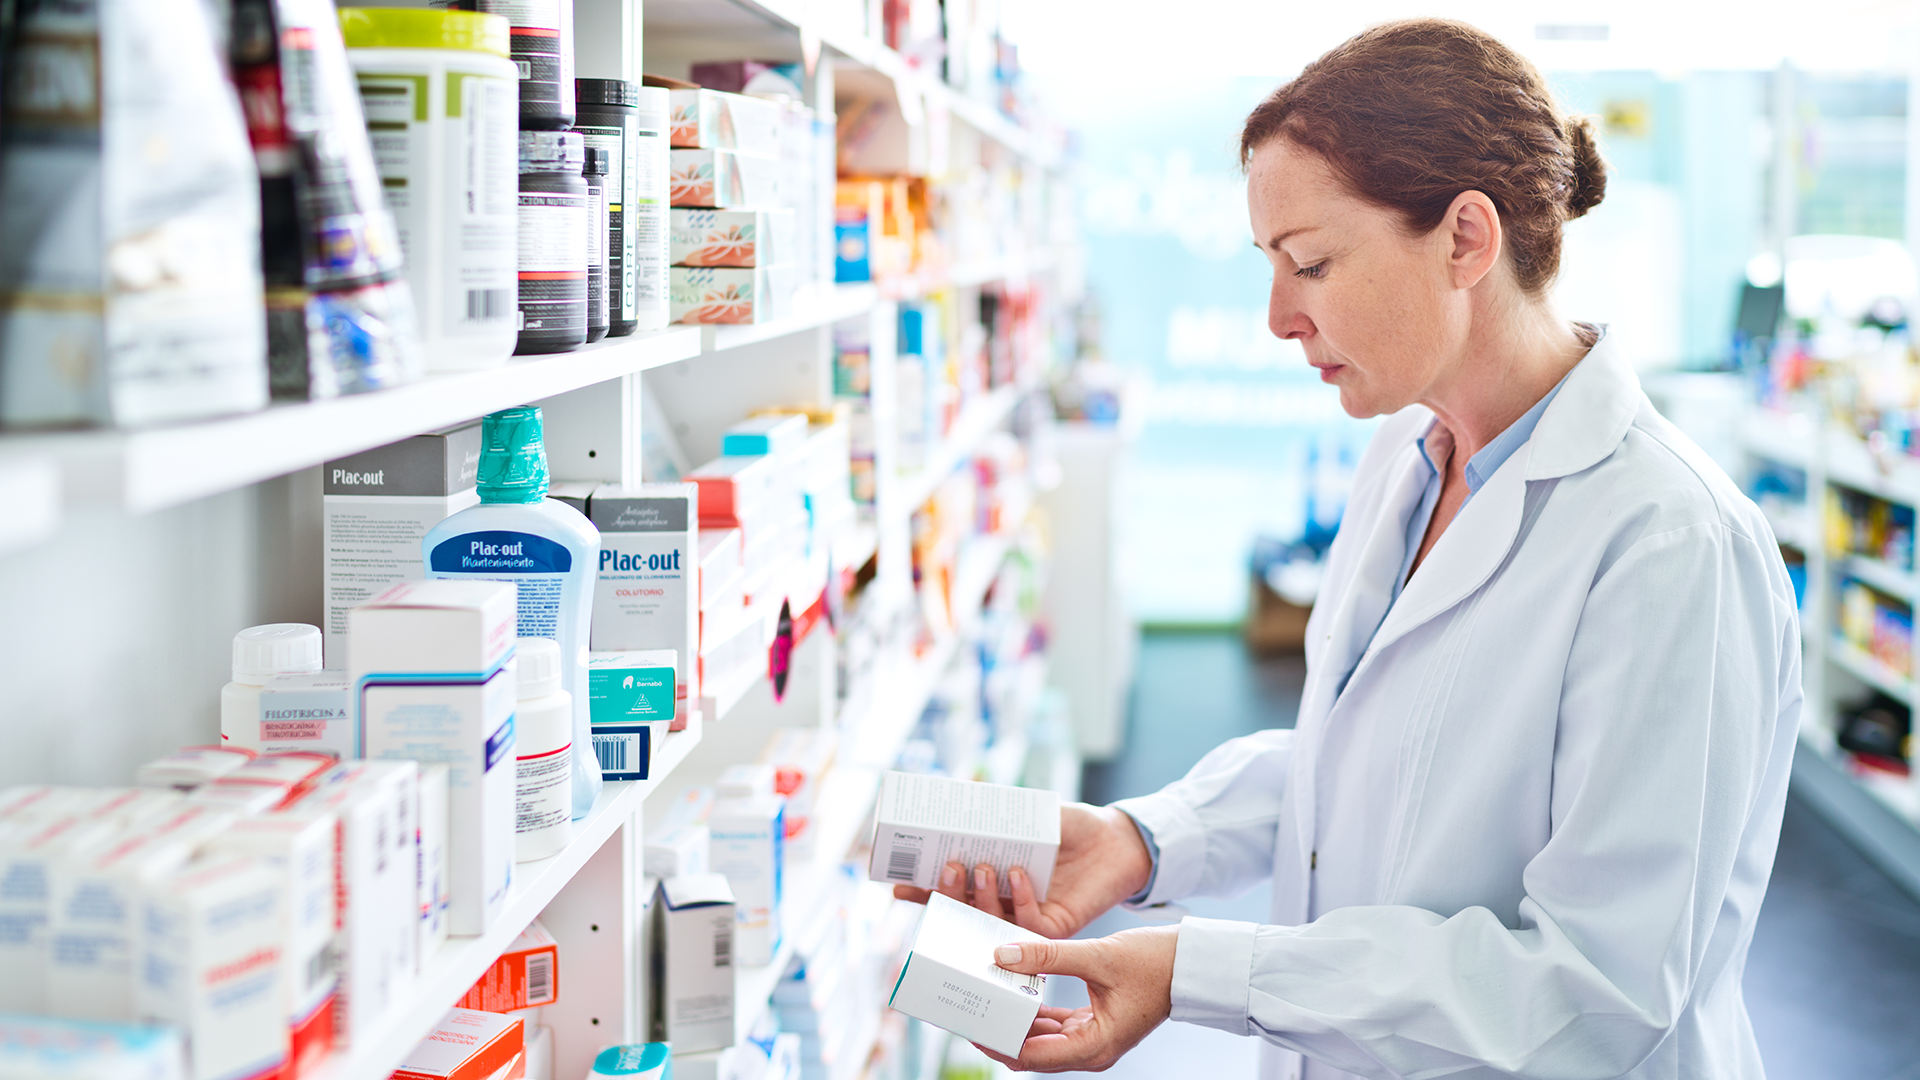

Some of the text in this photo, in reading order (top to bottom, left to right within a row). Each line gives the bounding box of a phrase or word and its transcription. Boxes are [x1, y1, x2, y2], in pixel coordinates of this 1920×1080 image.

[626, 234, 634, 308] CORE
[333, 469, 384, 485] Plac-out
[470, 541, 523, 556] Plac-out
[462, 555, 534, 568] Mantenimiento
[599, 548, 681, 572] Plac-out
[616, 588, 664, 596] COLUTORIO
[265, 708, 347, 719] FILOTRICIN A
